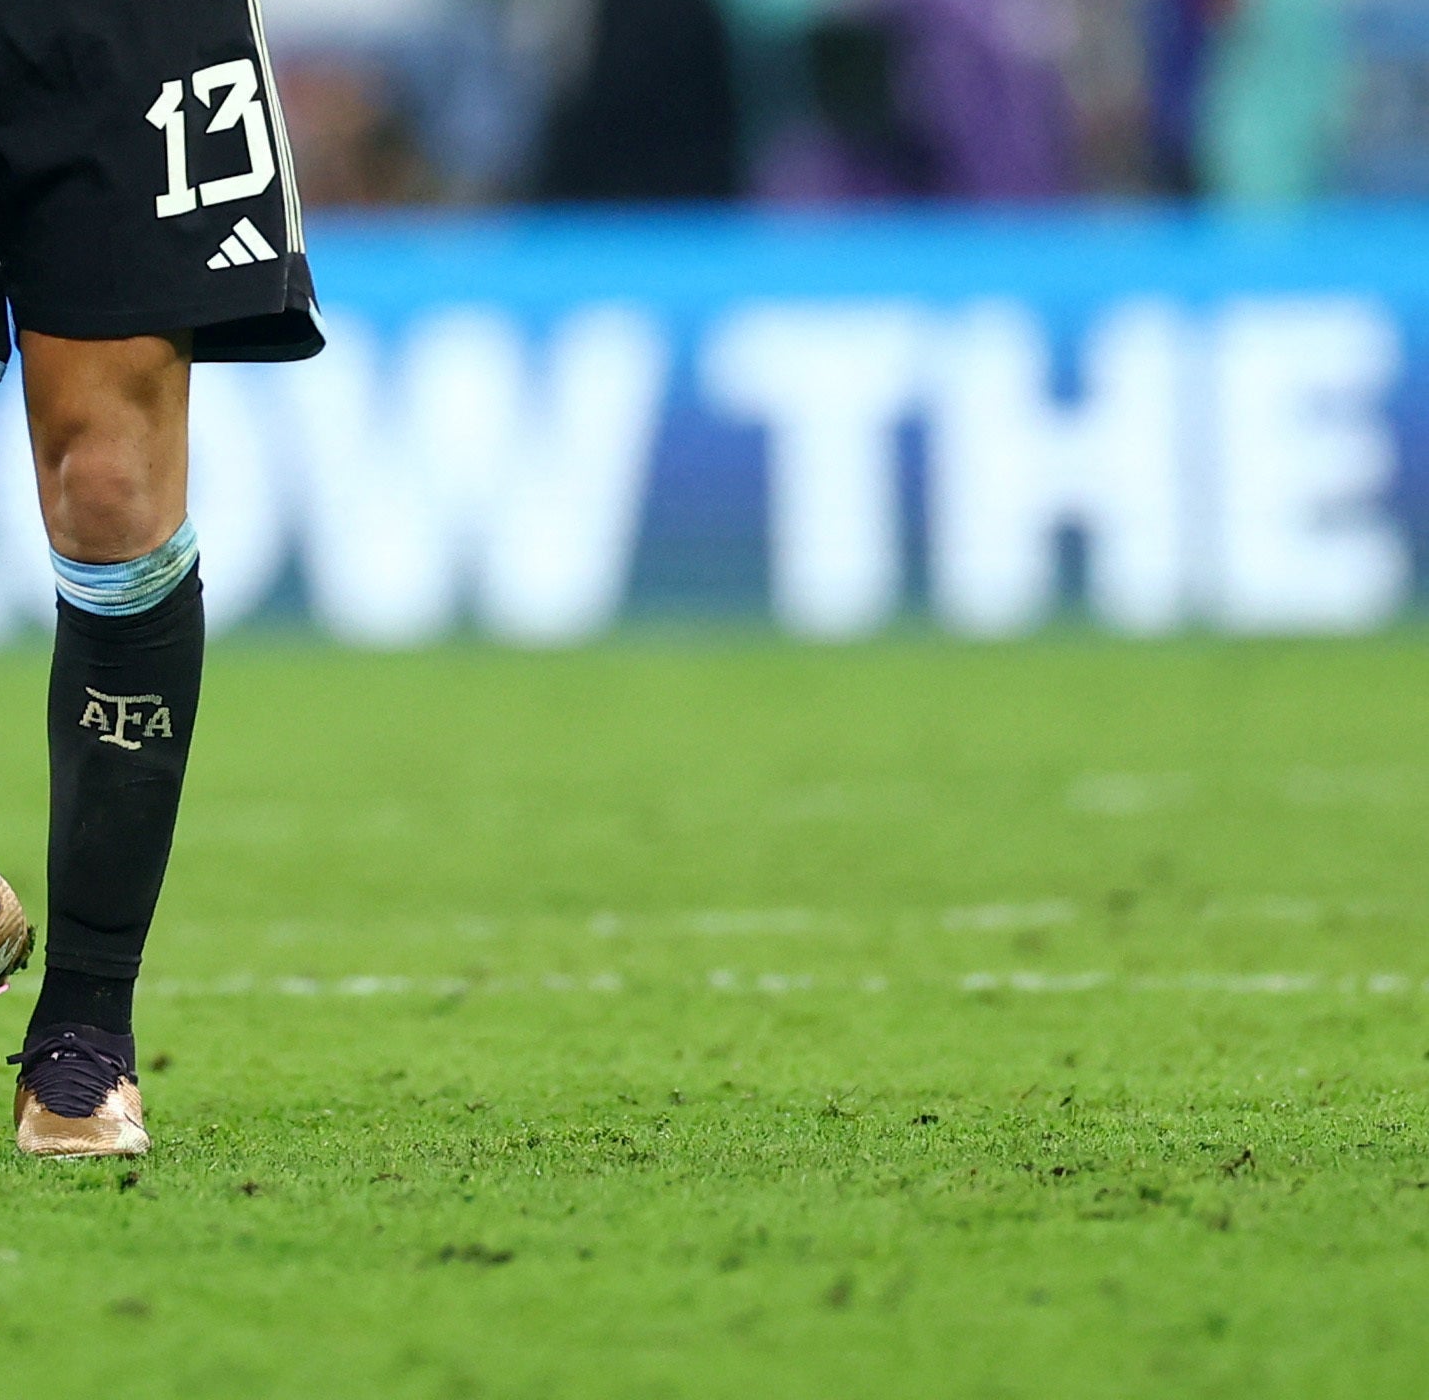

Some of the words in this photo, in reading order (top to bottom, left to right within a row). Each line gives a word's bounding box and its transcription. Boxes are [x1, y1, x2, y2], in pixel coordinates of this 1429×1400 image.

[144, 58, 276, 218] 13
[704, 292, 1406, 642] THE
[79, 686, 173, 751] AFA
